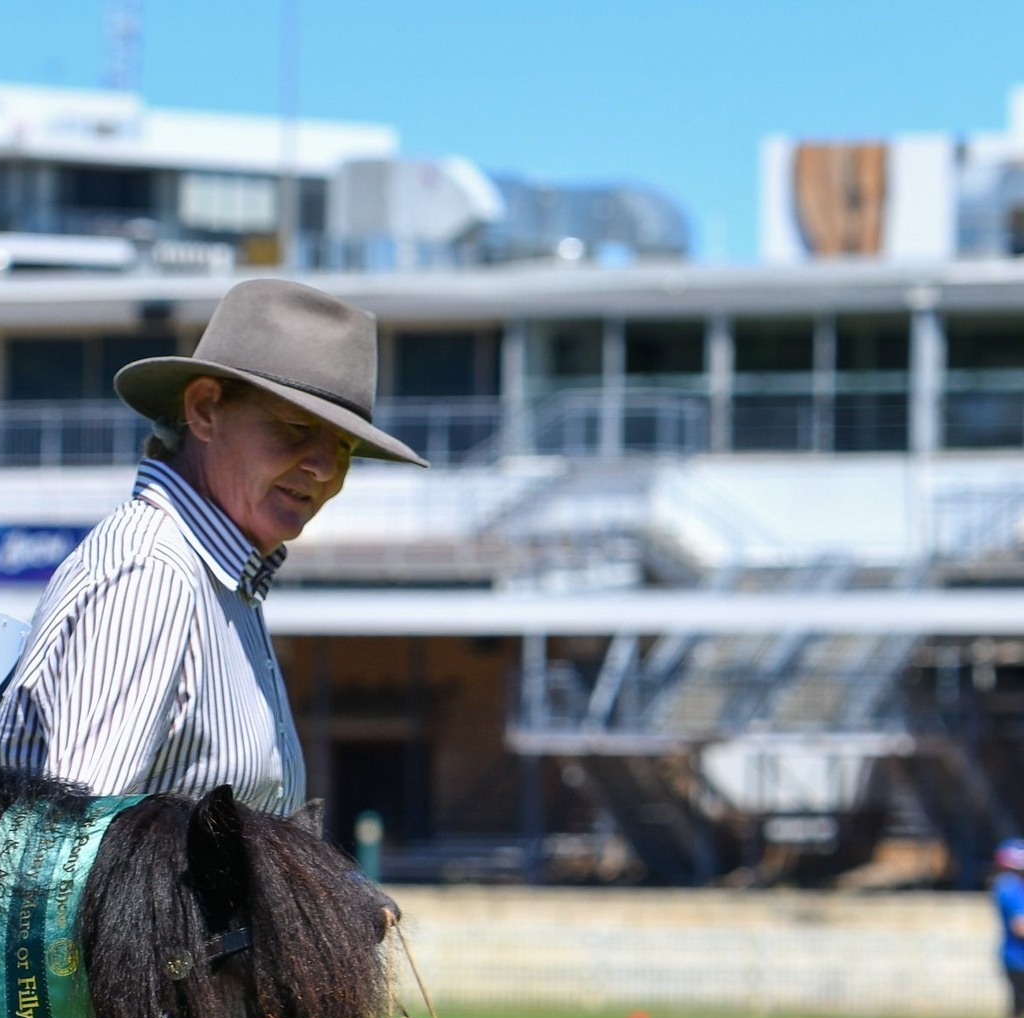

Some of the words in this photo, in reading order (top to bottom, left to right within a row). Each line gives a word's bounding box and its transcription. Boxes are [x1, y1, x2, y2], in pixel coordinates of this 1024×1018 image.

[0, 839, 20, 858] &
[62, 834, 90, 873] Pony
[18, 886, 42, 940] Mare
[16, 947, 29, 970] or
